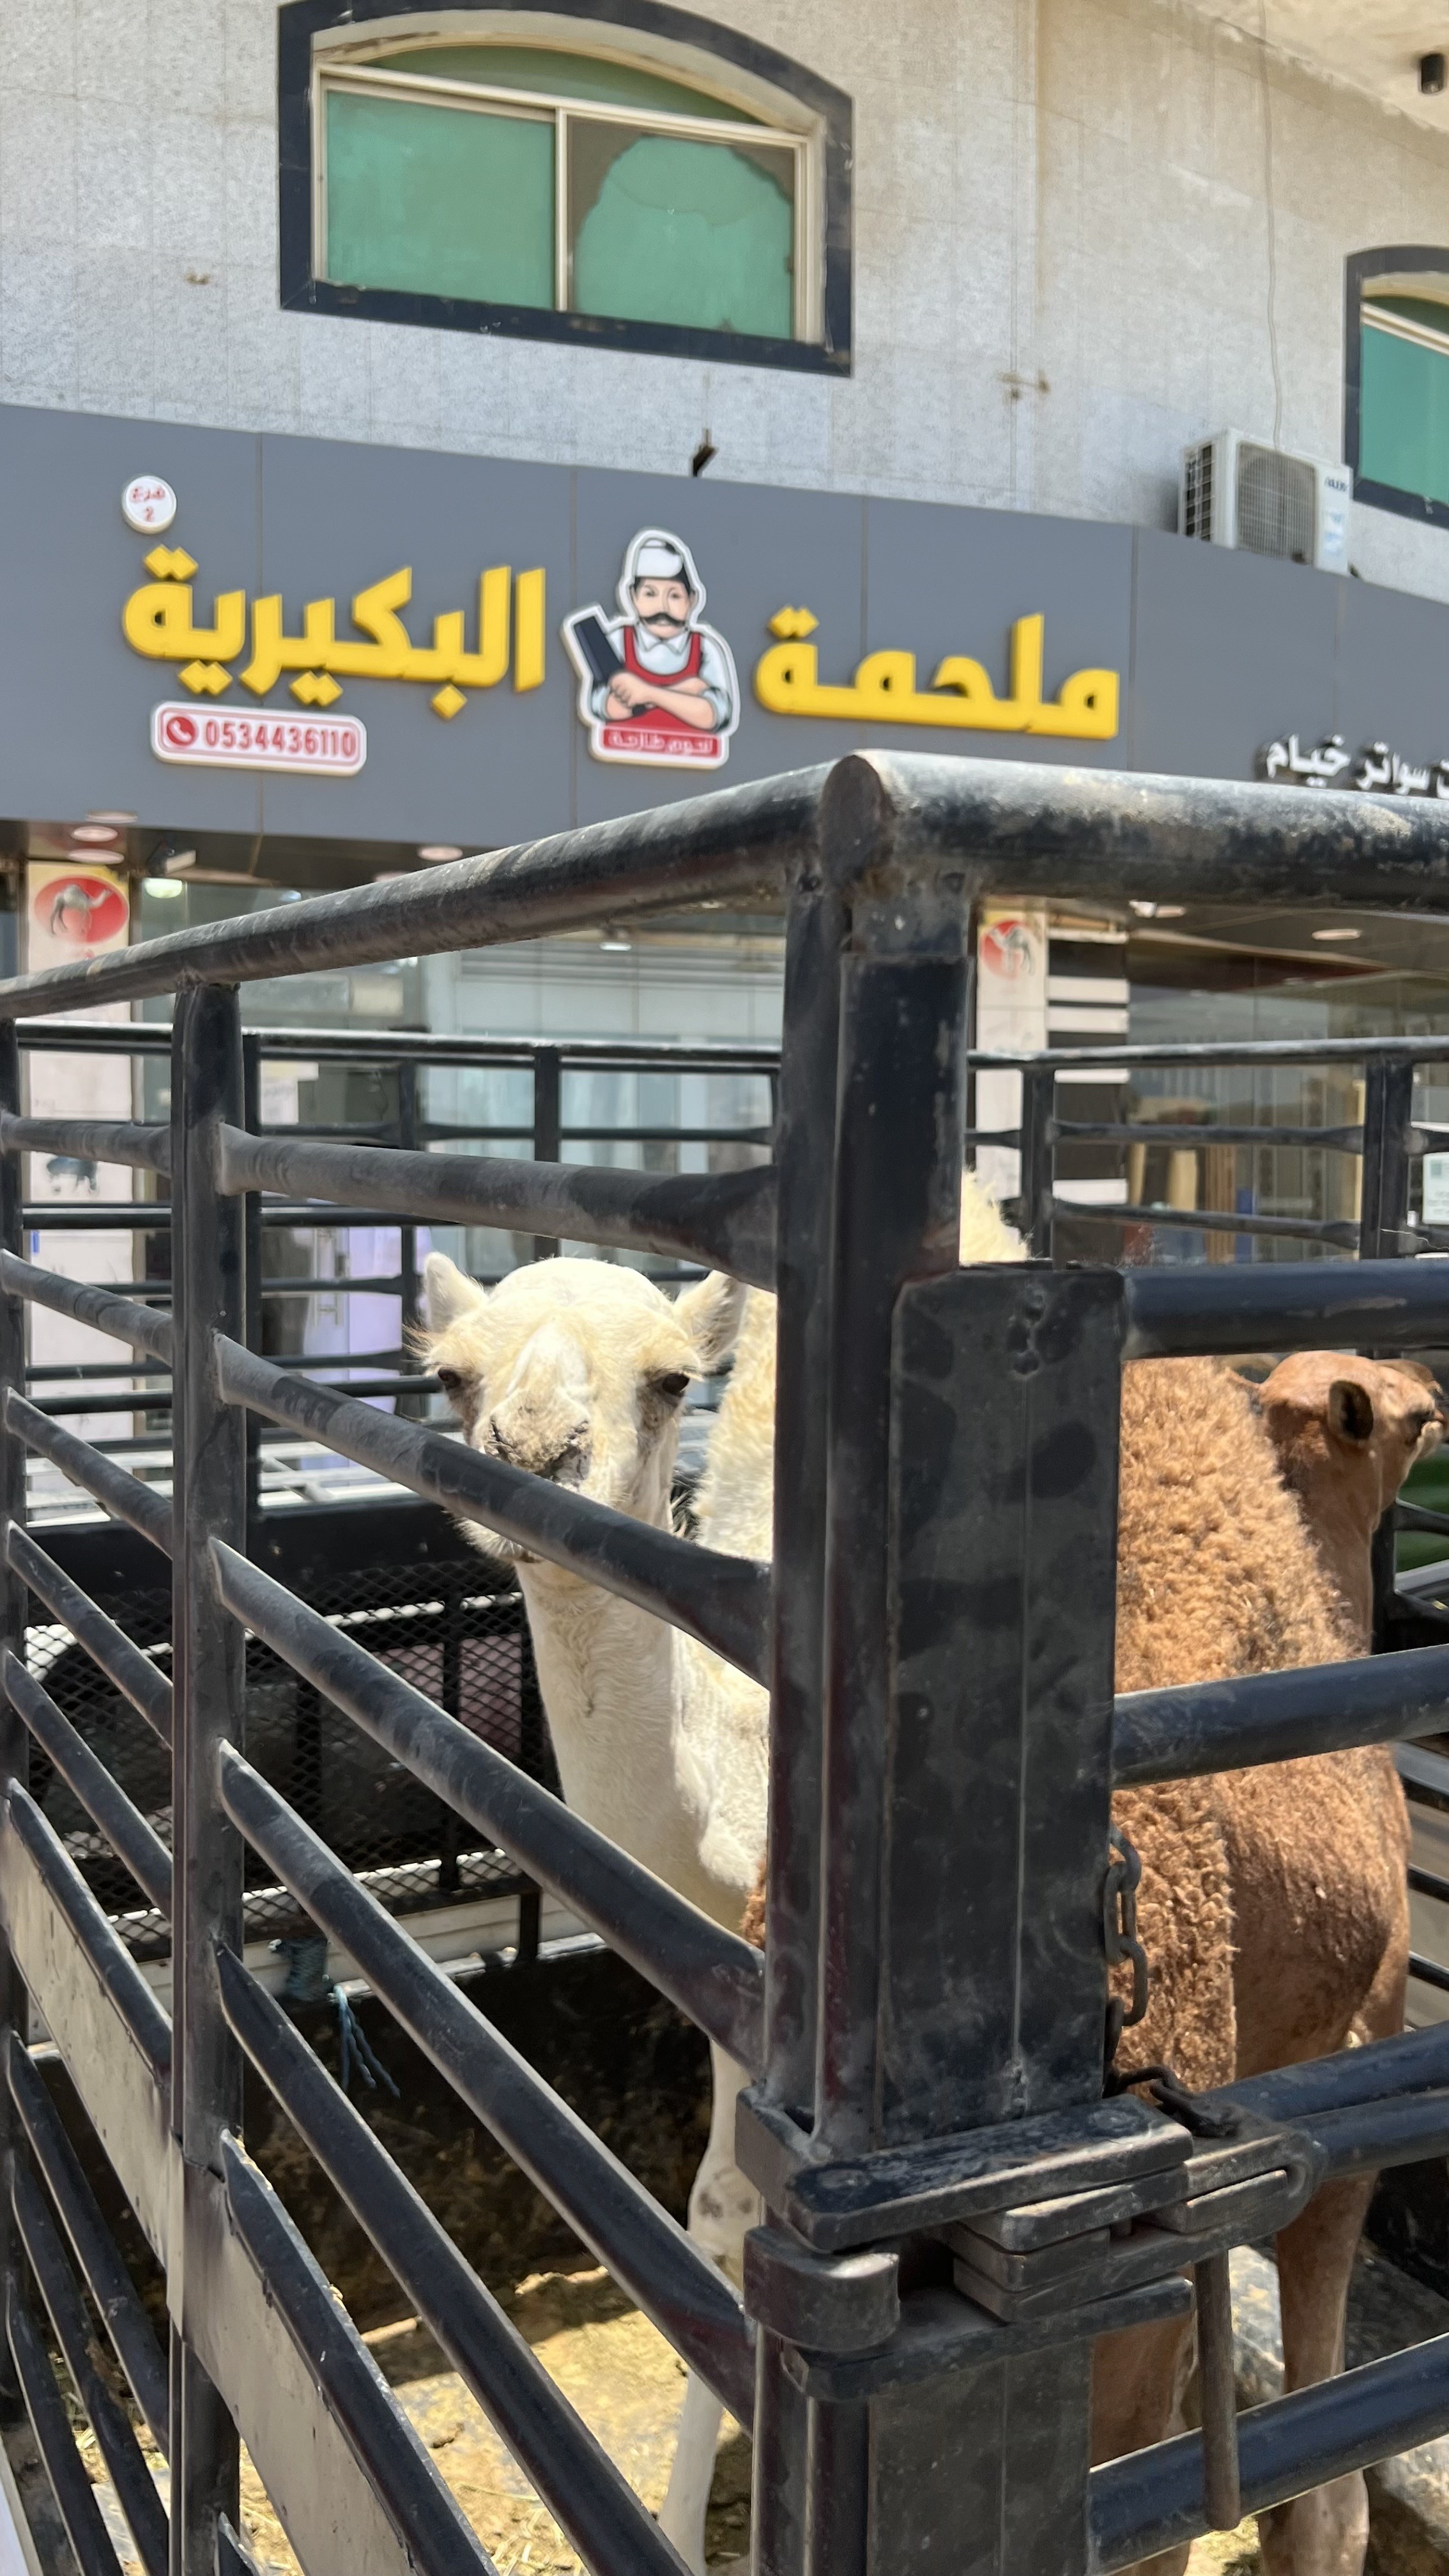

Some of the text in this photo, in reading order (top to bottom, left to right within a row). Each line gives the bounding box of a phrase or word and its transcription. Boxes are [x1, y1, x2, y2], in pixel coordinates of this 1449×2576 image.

[129, 486, 165, 503] فرع
[144, 506, 155, 522] 2
[122, 544, 1119, 739] ملحمة البكيرية
[205, 718, 358, 758] 0534436110
[608, 729, 714, 756] لحوم طازجة
[1266, 734, 1351, 788] خيام
